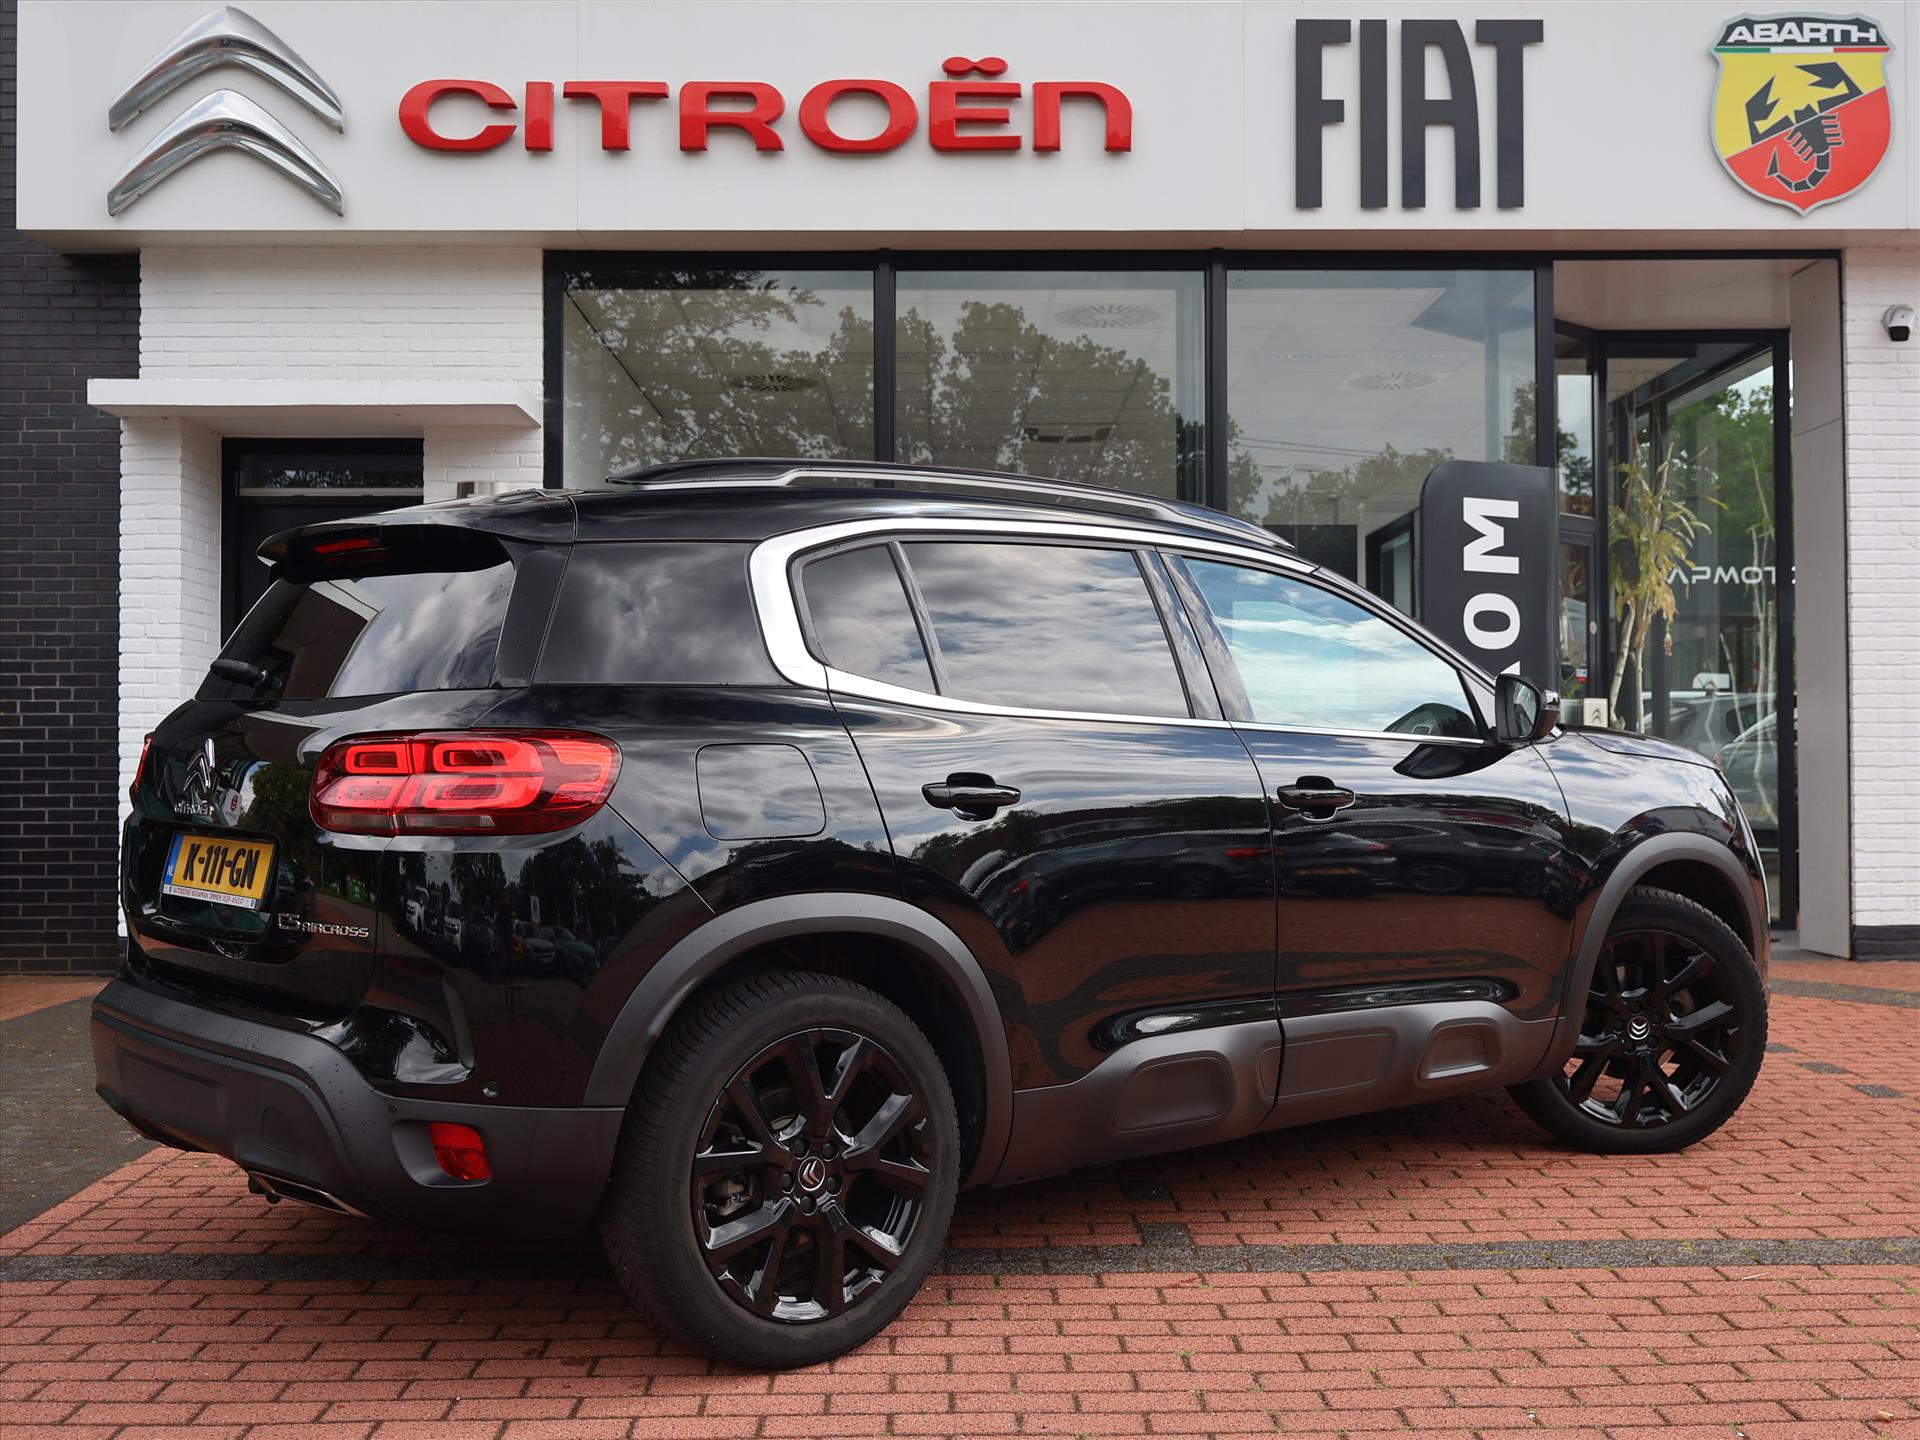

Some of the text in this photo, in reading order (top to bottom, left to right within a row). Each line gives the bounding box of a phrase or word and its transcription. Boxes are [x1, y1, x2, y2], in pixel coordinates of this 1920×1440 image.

[1726, 22, 1878, 43] ABARTH
[1295, 19, 1544, 208] FIAT
[1463, 497, 1521, 675] OM
[1666, 565, 1796, 585] APMOT
[182, 843, 261, 890] K-111-GN
[278, 913, 369, 938] C5 AIRCROSS
